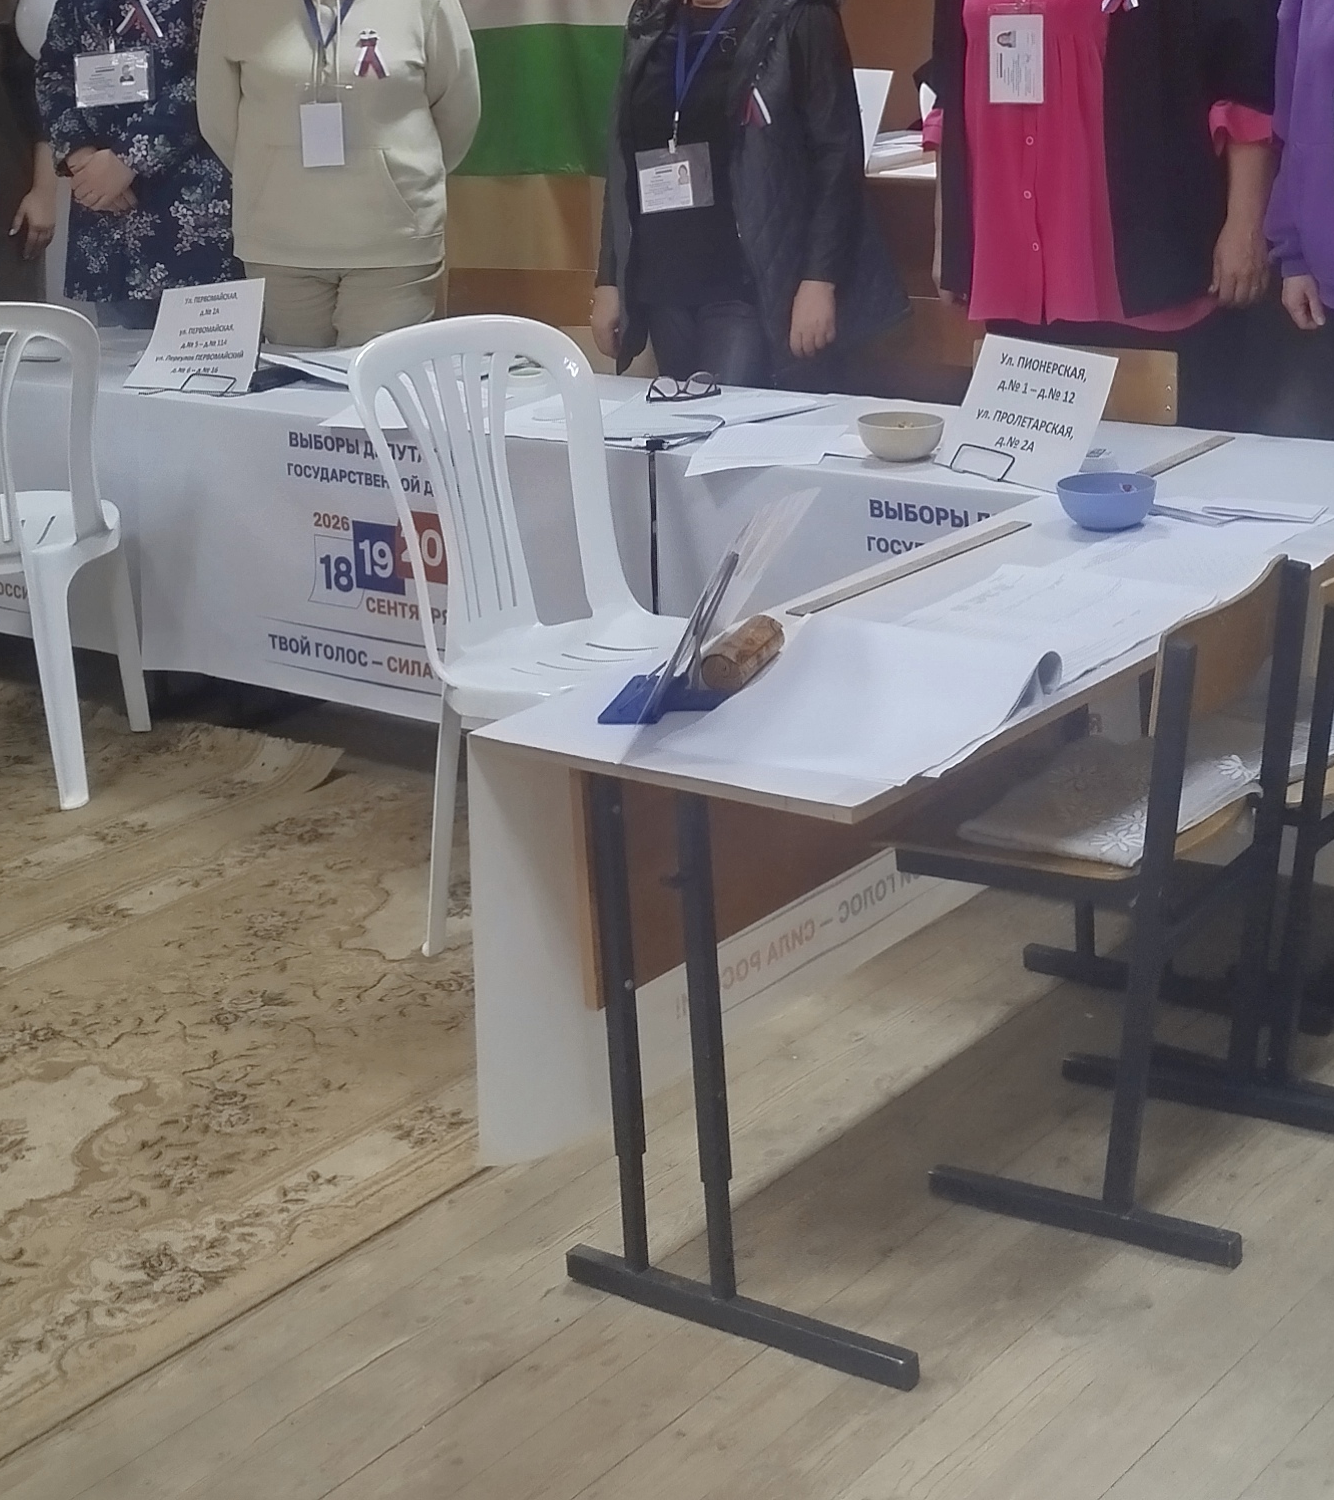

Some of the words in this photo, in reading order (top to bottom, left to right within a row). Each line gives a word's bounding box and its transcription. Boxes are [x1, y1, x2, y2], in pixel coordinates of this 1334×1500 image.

[1000, 352, 1015, 367] Ул.
[1017, 356, 1087, 383] ПИОНЕРСКАЯ,
[997, 379, 1021, 392] д.№
[1021, 382, 1029, 394] 1
[1062, 390, 1076, 405] 12
[976, 408, 991, 420] ул.
[992, 409, 1075, 441] ПРОЛЕТАРСКАЯ,
[288, 430, 359, 456] ВЫБОРЫ
[994, 436, 1020, 449] д.№
[1020, 440, 1035, 453] 2А
[286, 462, 421, 494] ГОСУДАРСТВЕНОЙ
[312, 512, 350, 532] 2026
[869, 499, 969, 528] ВЫБОРЫ
[319, 554, 354, 593] 18
[359, 539, 394, 578] 19
[268, 633, 311, 657] ТВОЙ
[314, 642, 368, 667] ГОЛОС
[386, 655, 434, 680] СИЛА
